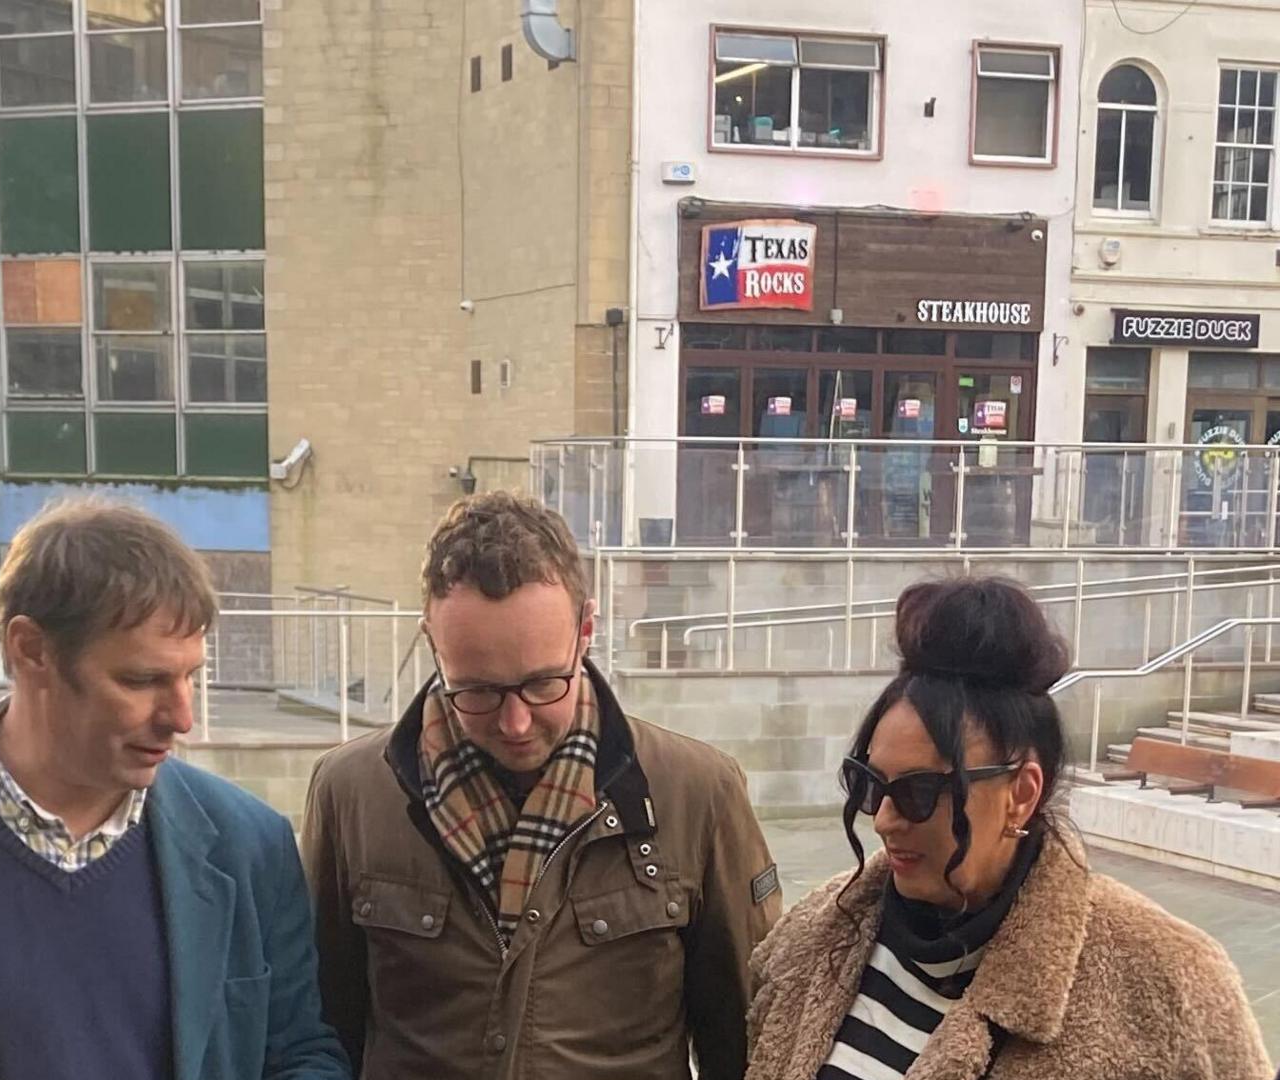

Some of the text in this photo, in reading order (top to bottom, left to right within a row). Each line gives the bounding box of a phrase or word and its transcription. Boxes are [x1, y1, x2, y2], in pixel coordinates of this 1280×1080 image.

[744, 234, 809, 263] TEXAS
[744, 269, 806, 299] ROCKS
[916, 298, 1032, 325] STEAKHOUSE
[1122, 316, 1252, 342] FUZZIE DUCK
